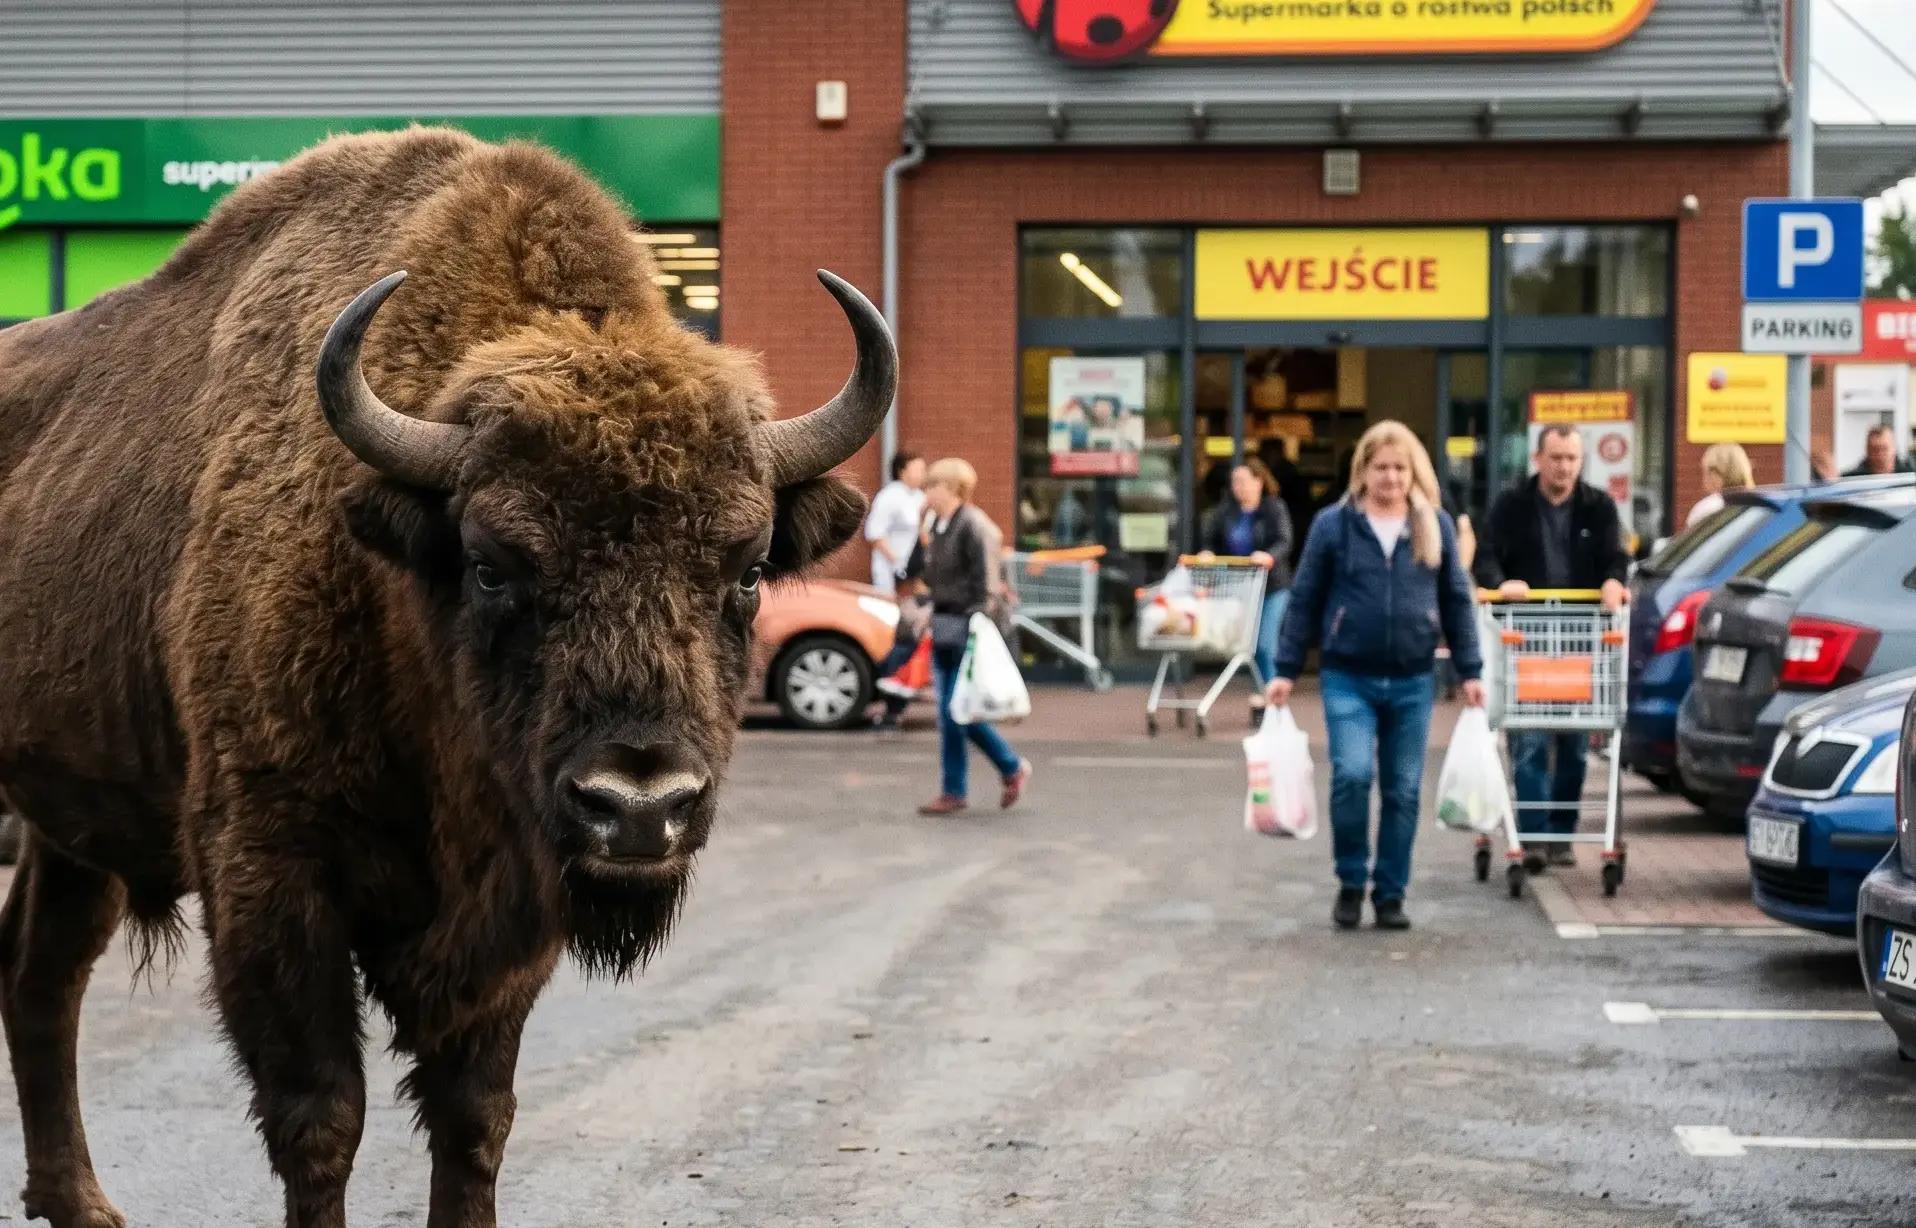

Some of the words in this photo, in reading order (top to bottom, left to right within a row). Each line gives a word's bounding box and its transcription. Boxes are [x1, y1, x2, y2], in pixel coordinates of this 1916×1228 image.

[1246, 245, 1438, 293] WEJŚCIE
[1778, 212, 1835, 288] P
[1751, 317, 1853, 338] PARKING
